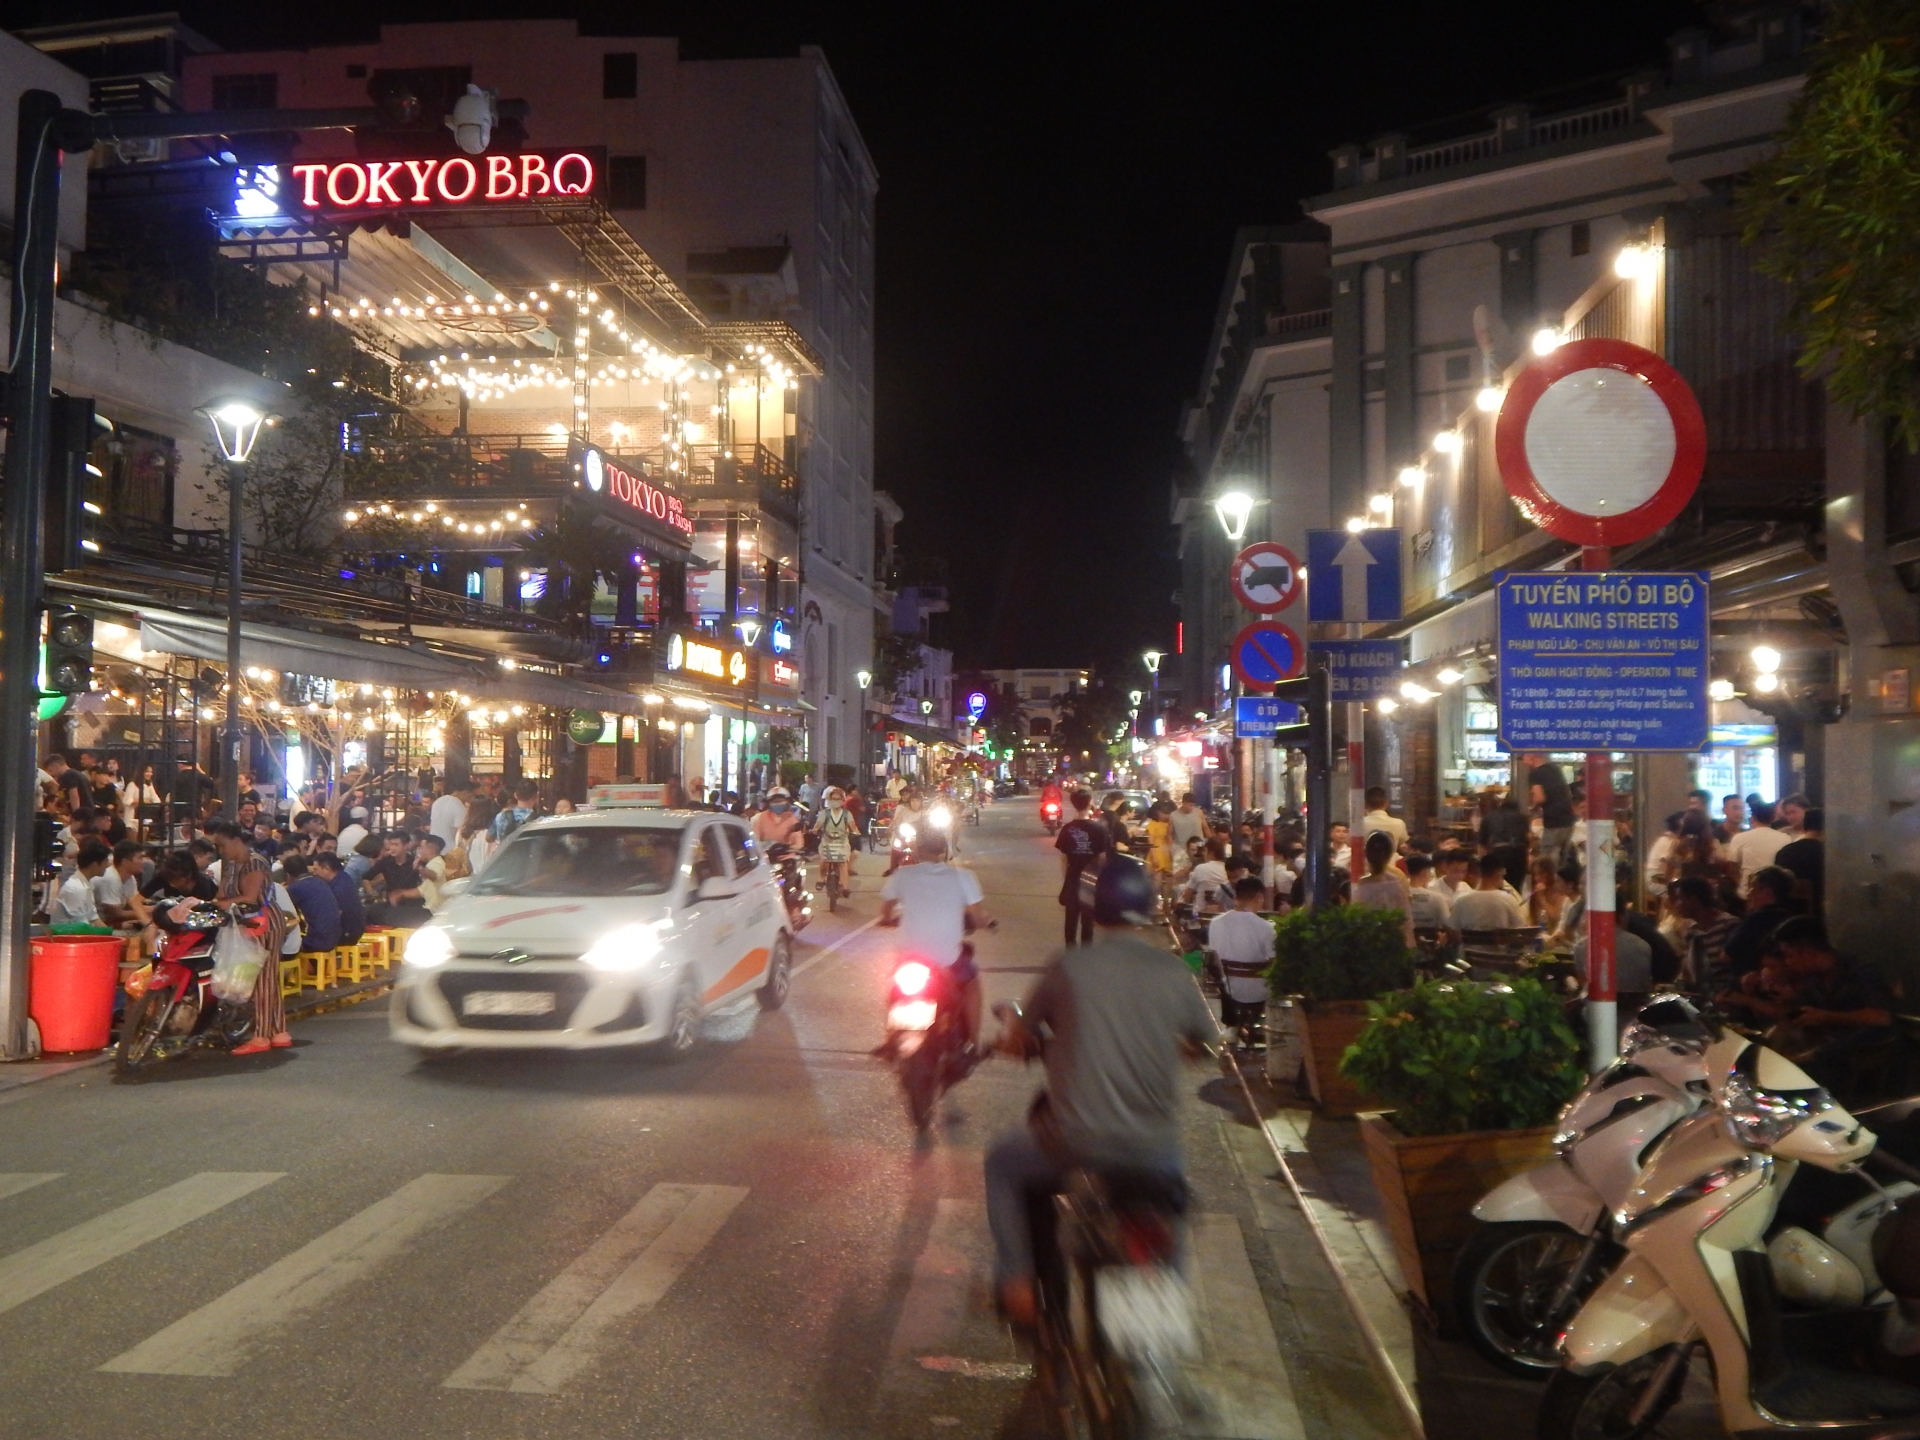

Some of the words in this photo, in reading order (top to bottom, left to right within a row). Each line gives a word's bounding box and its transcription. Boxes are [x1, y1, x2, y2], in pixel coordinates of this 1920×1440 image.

[292, 157, 477, 207] TOKYO
[485, 153, 593, 199] BBQ
[606, 462, 666, 519] TOKYO
[668, 495, 683, 514] BBQ
[1510, 576, 1580, 604] TUYẾN
[1587, 576, 1632, 604] PHỐ
[1637, 584, 1658, 604] ĐI
[1664, 578, 1694, 608] BỘ
[1528, 611, 1602, 629] WALKING
[1606, 611, 1679, 630] STREETS
[1508, 639, 1535, 651] PHẠM
[1585, 639, 1604, 650] CHU
[1627, 639, 1640, 650] AN
[1348, 648, 1395, 667] KHÁCH
[1534, 667, 1557, 677] GIAN
[1620, 666, 1671, 677] OPERATION
[1675, 666, 1698, 678] TIME
[1524, 688, 1549, 697] 18h00
[1555, 688, 1576, 697] 2h00
[1257, 703, 1265, 716] Ô
[1267, 703, 1279, 716] TÔ
[1511, 700, 1532, 709] From
[1534, 700, 1556, 709] 18:00
[1558, 700, 1567, 709] to
[1568, 700, 1586, 709] 2:00
[1588, 700, 1615, 711] during
[1617, 700, 1643, 711] Friday
[1644, 700, 1661, 709] and
[1511, 731, 1533, 740] From
[1535, 731, 1557, 740] 18:00
[1559, 731, 1568, 740] to
[1569, 731, 1592, 740] 24:00
[1593, 732, 1605, 740] on
[1606, 731, 1637, 743] Snday
